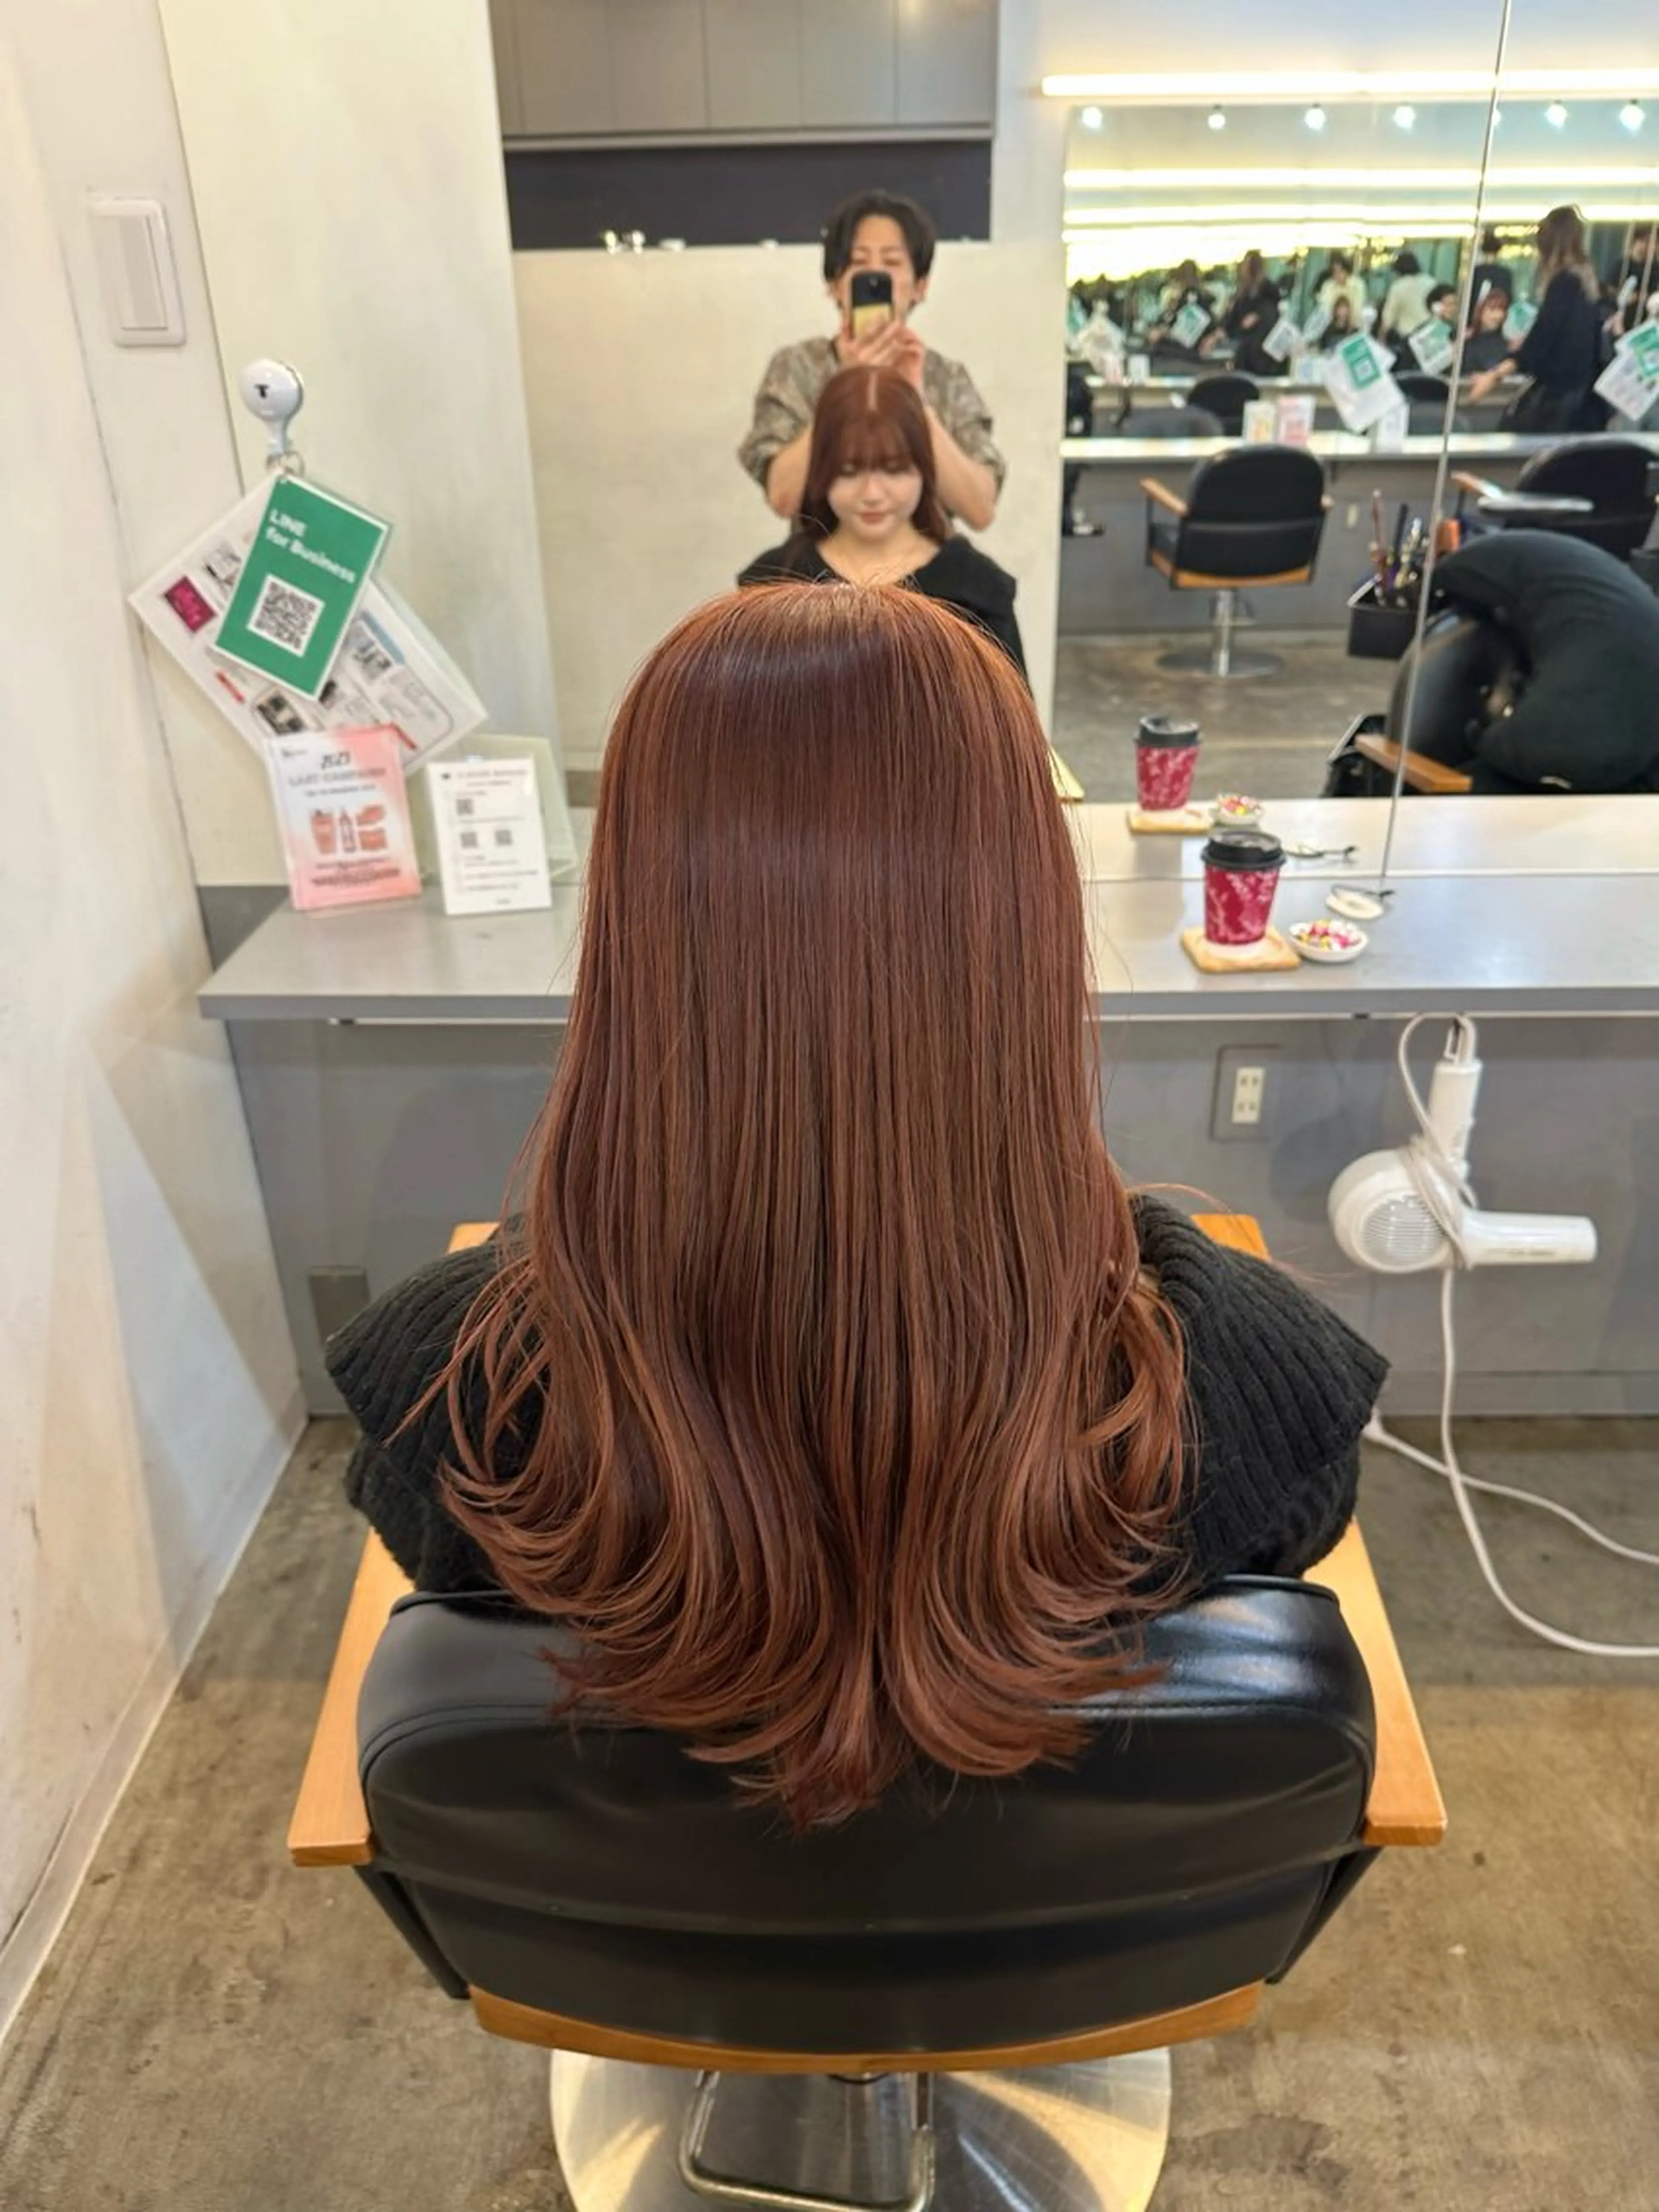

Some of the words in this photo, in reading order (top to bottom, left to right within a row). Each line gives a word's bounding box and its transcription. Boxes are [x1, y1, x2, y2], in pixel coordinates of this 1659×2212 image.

[270, 509, 307, 537] LINE
[266, 527, 289, 548] for
[290, 539, 356, 583] Business
